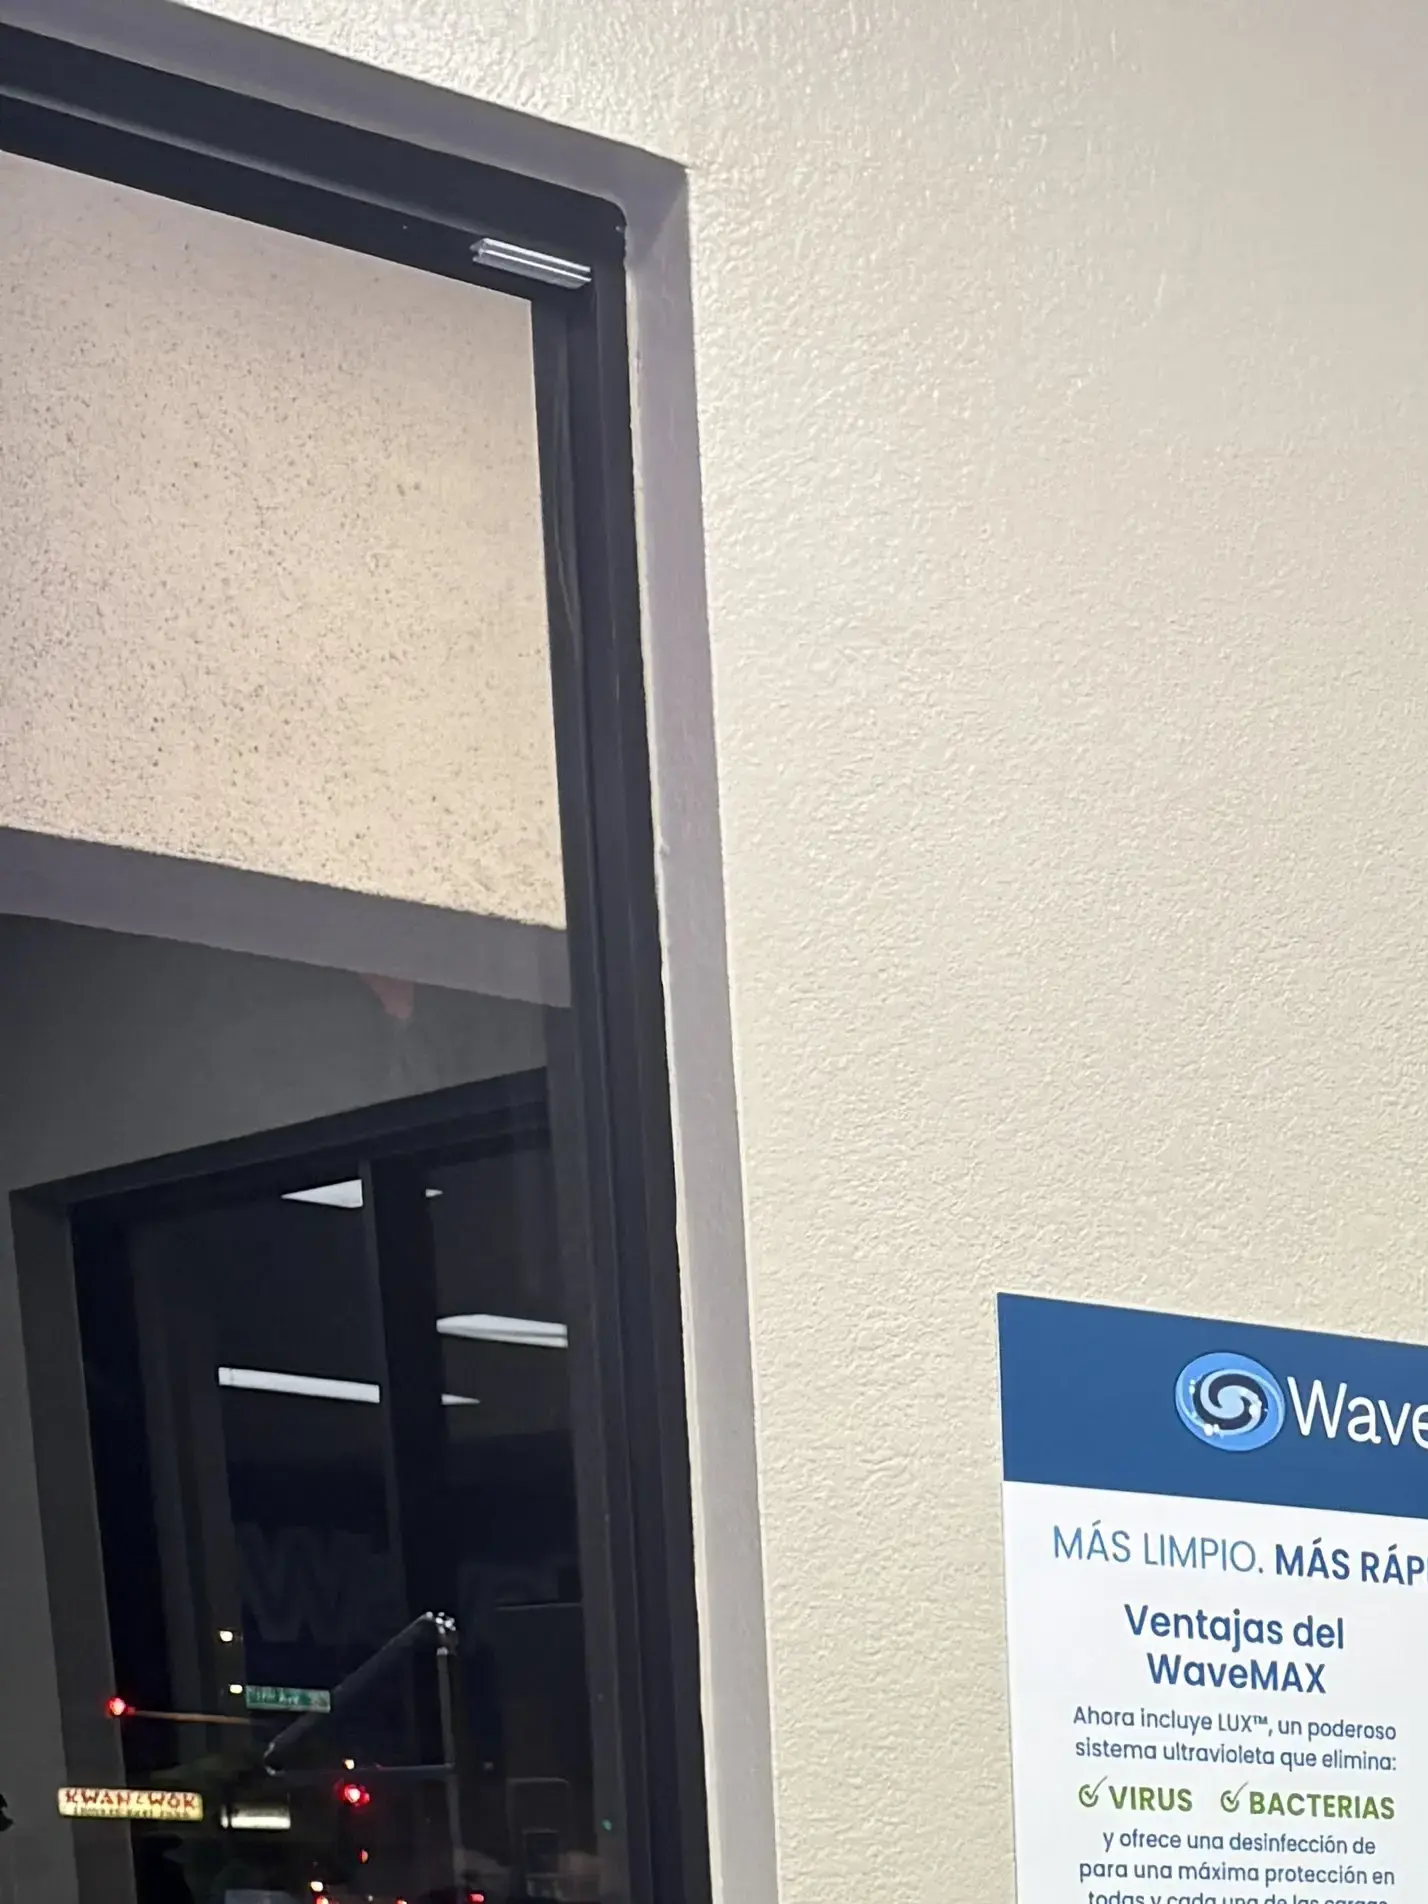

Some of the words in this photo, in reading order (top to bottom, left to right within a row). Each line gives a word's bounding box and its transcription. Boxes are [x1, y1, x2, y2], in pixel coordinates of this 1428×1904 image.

[1053, 1519, 1130, 1562] MÁS
[1143, 1532, 1263, 1573] LIMPIO.
[1275, 1536, 1350, 1580] MÁS
[1124, 1603, 1283, 1653] Ventajas
[1292, 1614, 1343, 1649] del
[1146, 1652, 1326, 1694] WaveMAX
[1073, 1705, 1134, 1726] Ahora
[1140, 1707, 1212, 1736] incluye
[1277, 1719, 1302, 1735] un
[1307, 1719, 1396, 1742] poderoso
[1075, 1736, 1156, 1759] sistema
[1163, 1741, 1275, 1765] ultravioleta
[1280, 1751, 1317, 1772] que
[1321, 1749, 1396, 1770] elimina:
[1108, 1785, 1192, 1812] VIRUS
[1249, 1791, 1394, 1820] BACTERIAS
[1102, 1831, 1114, 1853] y
[1119, 1828, 1181, 1848] ofrece
[1187, 1834, 1224, 1850] una
[1229, 1832, 1347, 1854] desinfección
[1352, 1836, 1376, 1855] de
[1079, 1862, 1128, 1883] para
[1134, 1864, 1172, 1879] una
[1178, 1861, 1259, 1881] máxima
[1265, 1865, 1367, 1888] protección
[1372, 1870, 1394, 1885] en
